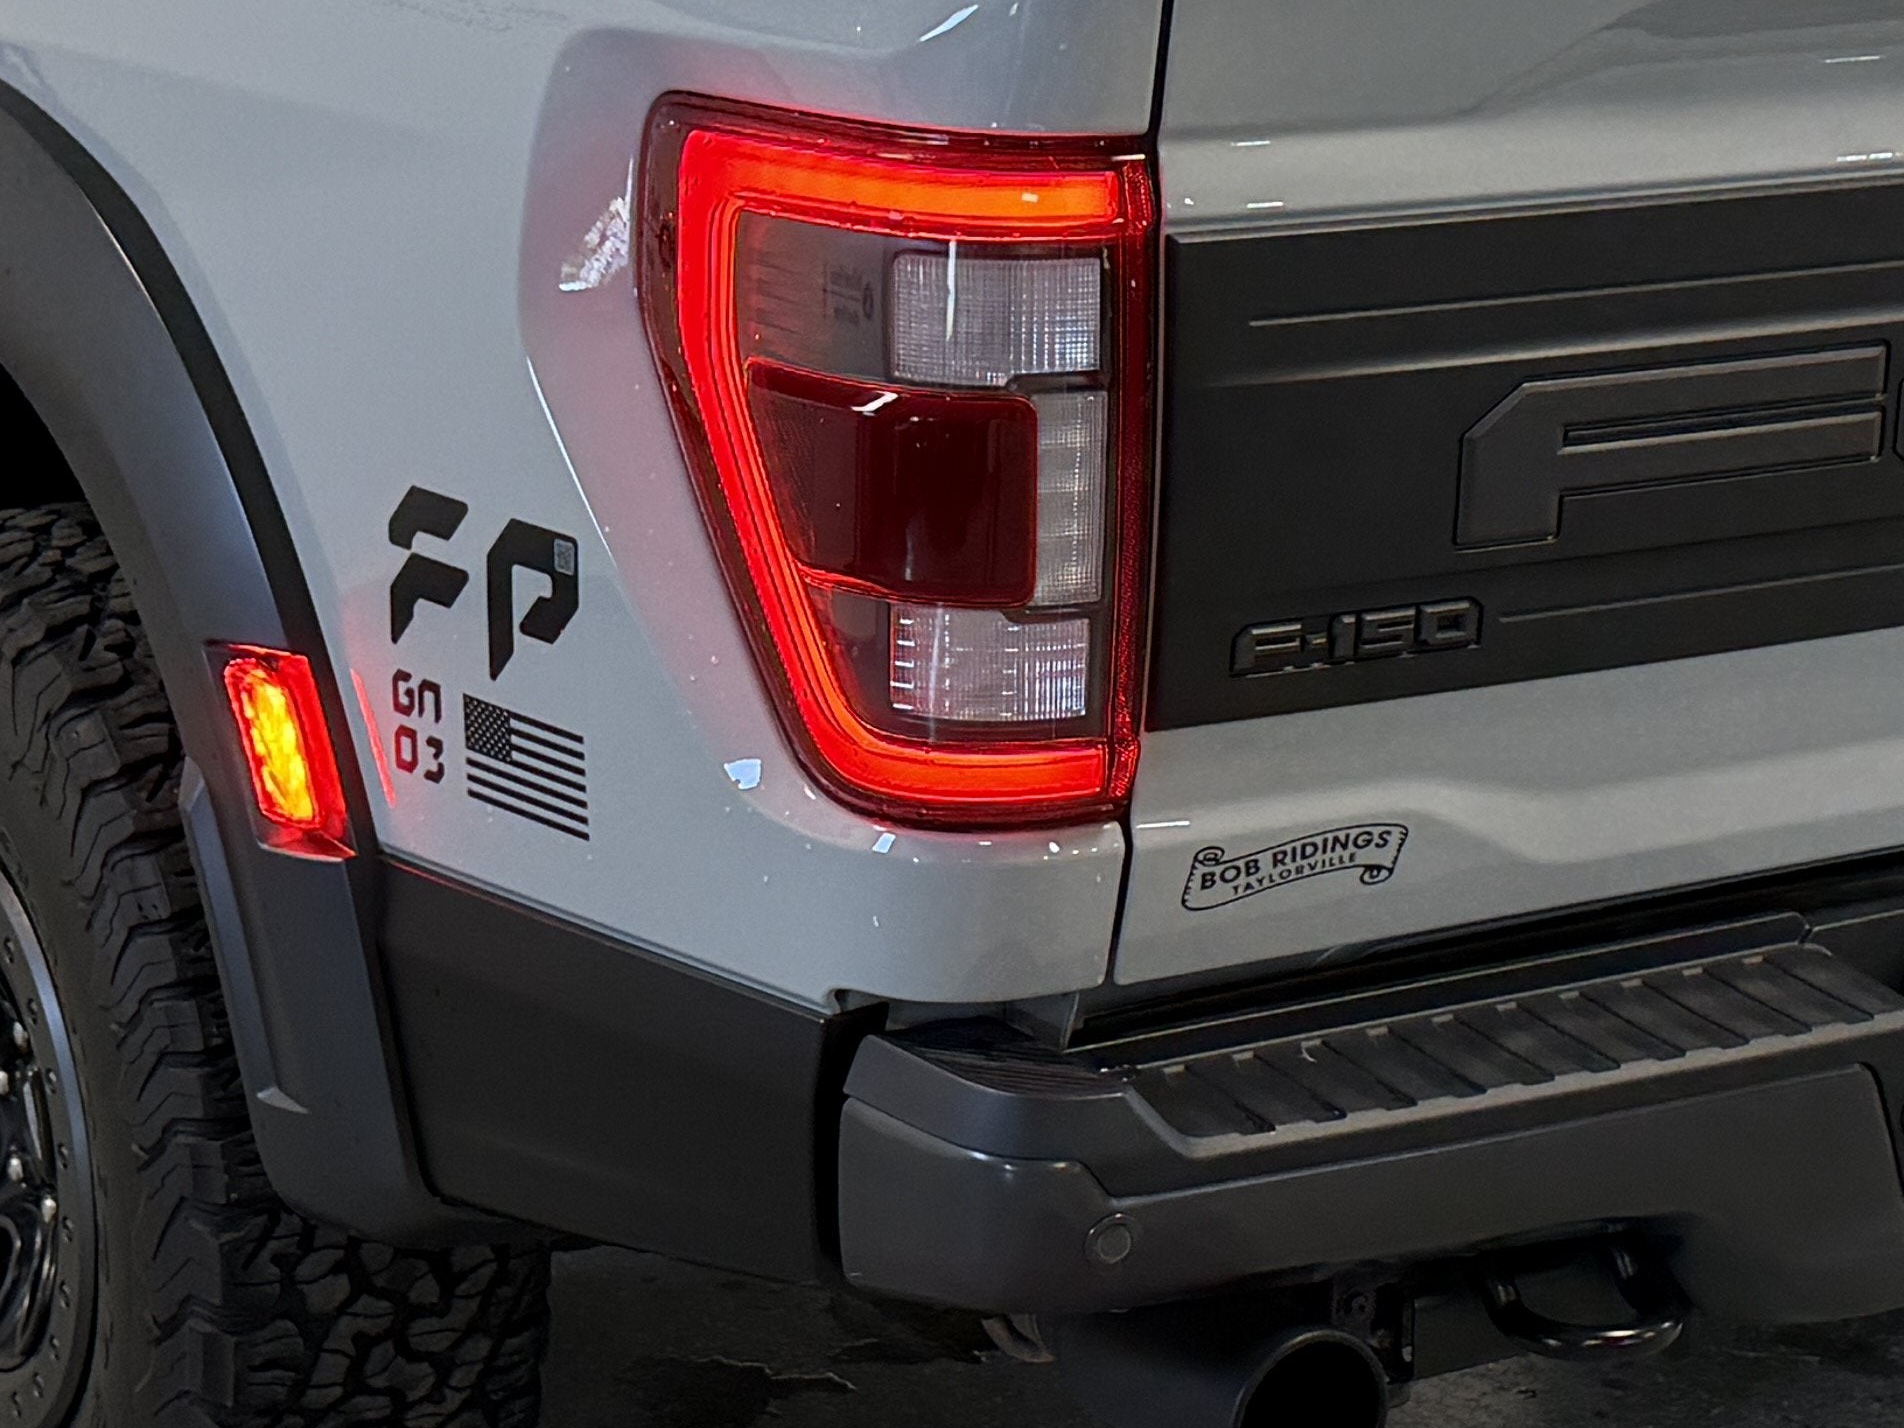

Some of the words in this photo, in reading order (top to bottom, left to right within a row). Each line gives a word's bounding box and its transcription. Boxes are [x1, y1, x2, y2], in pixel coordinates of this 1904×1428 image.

[1230, 596, 1484, 678] F-150
[1200, 857, 1261, 891] BOB
[1271, 828, 1393, 871] RIDINGS
[1232, 851, 1358, 897] TAYLORVILLE
